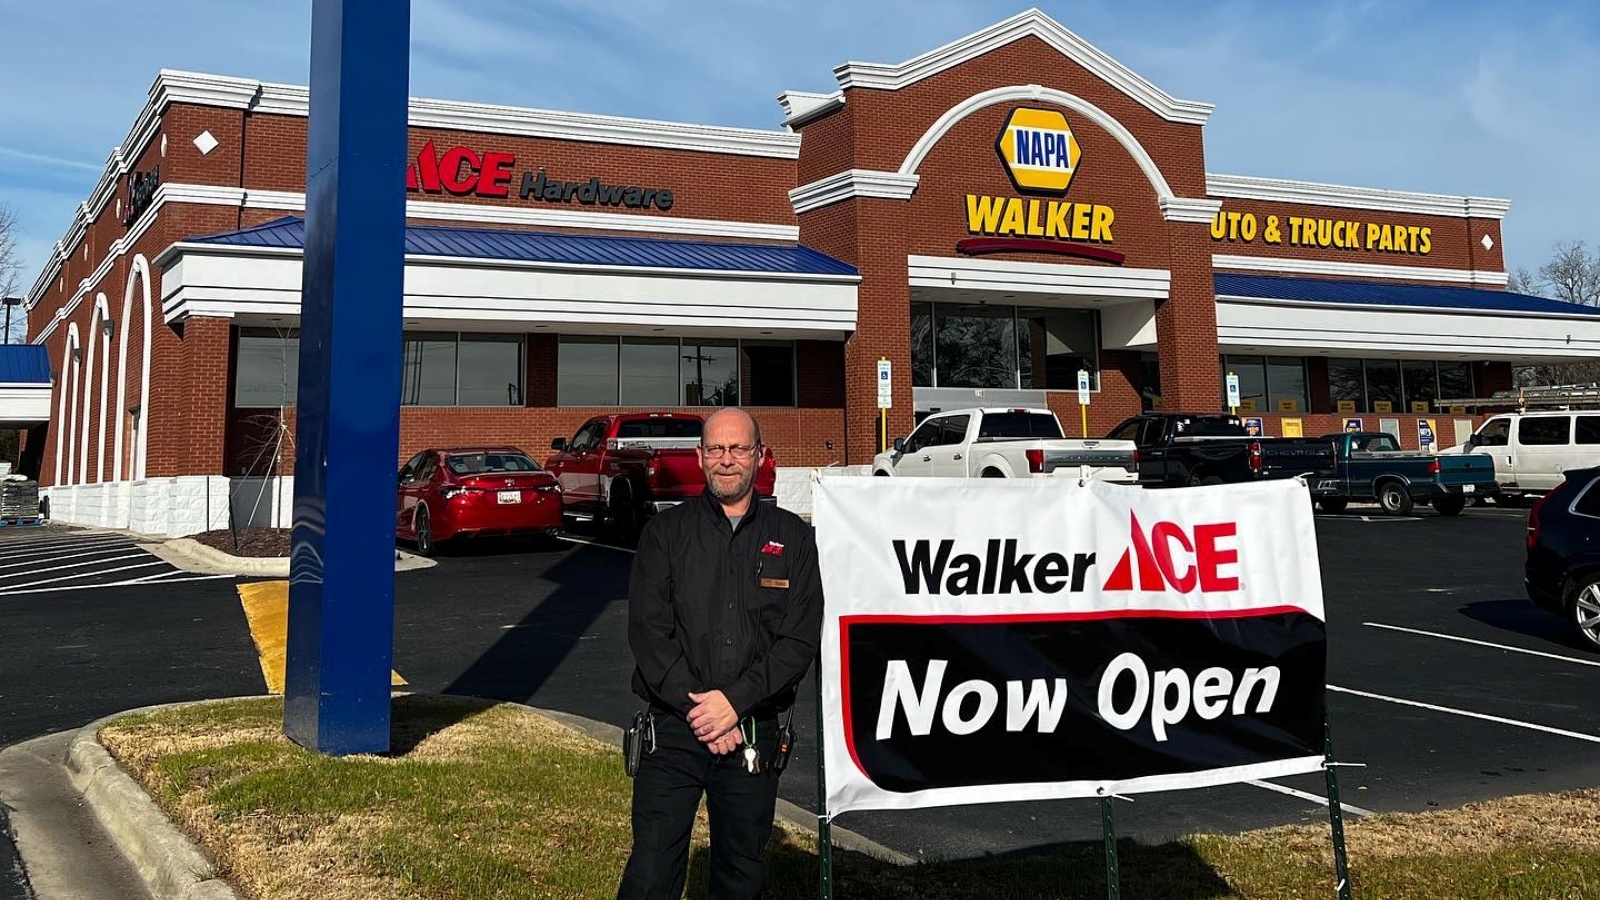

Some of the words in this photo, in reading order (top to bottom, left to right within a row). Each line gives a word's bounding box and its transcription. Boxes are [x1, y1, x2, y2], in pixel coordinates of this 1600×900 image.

[407, 139, 515, 197] ACE
[519, 171, 674, 211] Hardware
[1015, 129, 1070, 169] NAPA
[965, 194, 1116, 242] WALKER
[1209, 211, 1258, 241] UTO
[1264, 213, 1282, 244] &
[1289, 216, 1360, 249] TRUCK
[1366, 223, 1432, 254] PARTS
[892, 538, 1097, 597] Walker
[1102, 508, 1239, 594] ACE
[875, 658, 1068, 742] Now
[1097, 651, 1282, 742] Open
